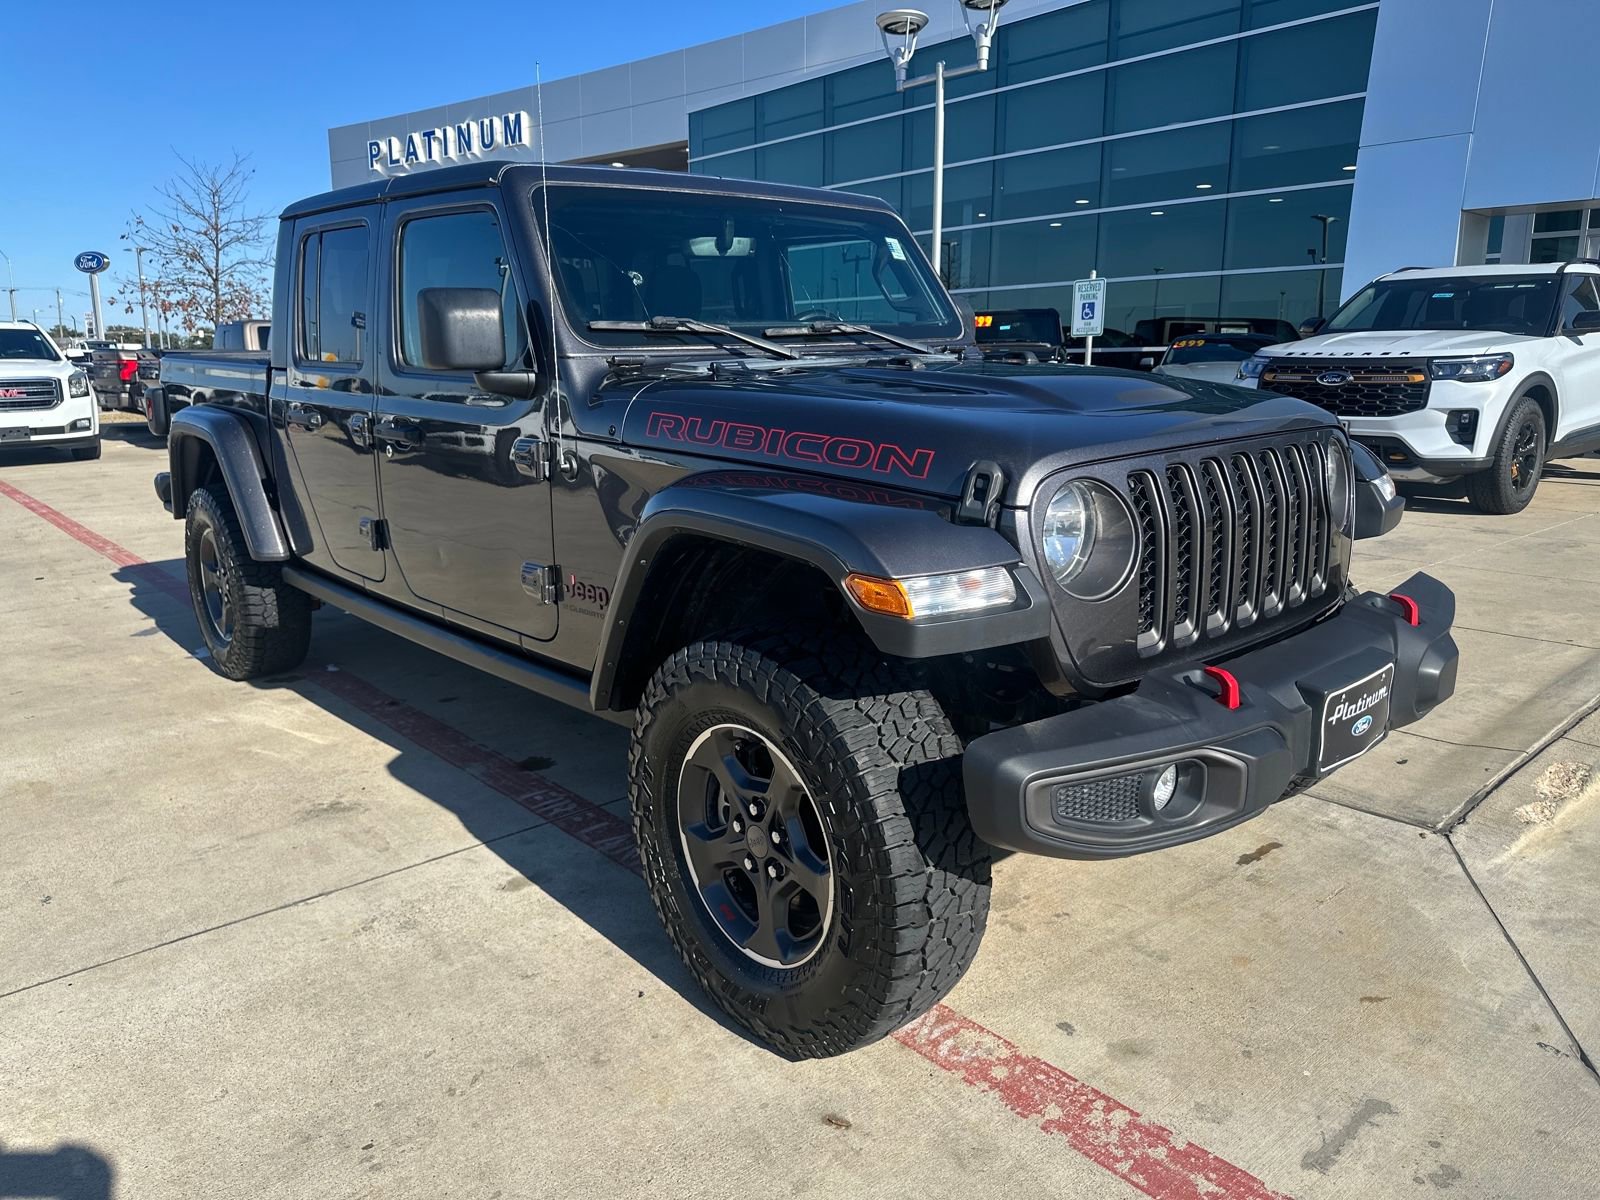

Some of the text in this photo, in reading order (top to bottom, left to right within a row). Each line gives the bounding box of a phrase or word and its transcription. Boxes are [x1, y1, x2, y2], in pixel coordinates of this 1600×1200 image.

[368, 111, 525, 170] PLATINUM
[80, 255, 97, 268] Ford
[1078, 282, 1101, 293] RESERVED
[1080, 292, 1098, 301] PARKING
[1323, 374, 1342, 383] Ford
[0, 388, 26, 398] MC
[645, 411, 936, 479] RUBICON
[569, 574, 610, 611] Jeep
[569, 604, 606, 619] GLADIATO
[1328, 685, 1388, 725] Platinum
